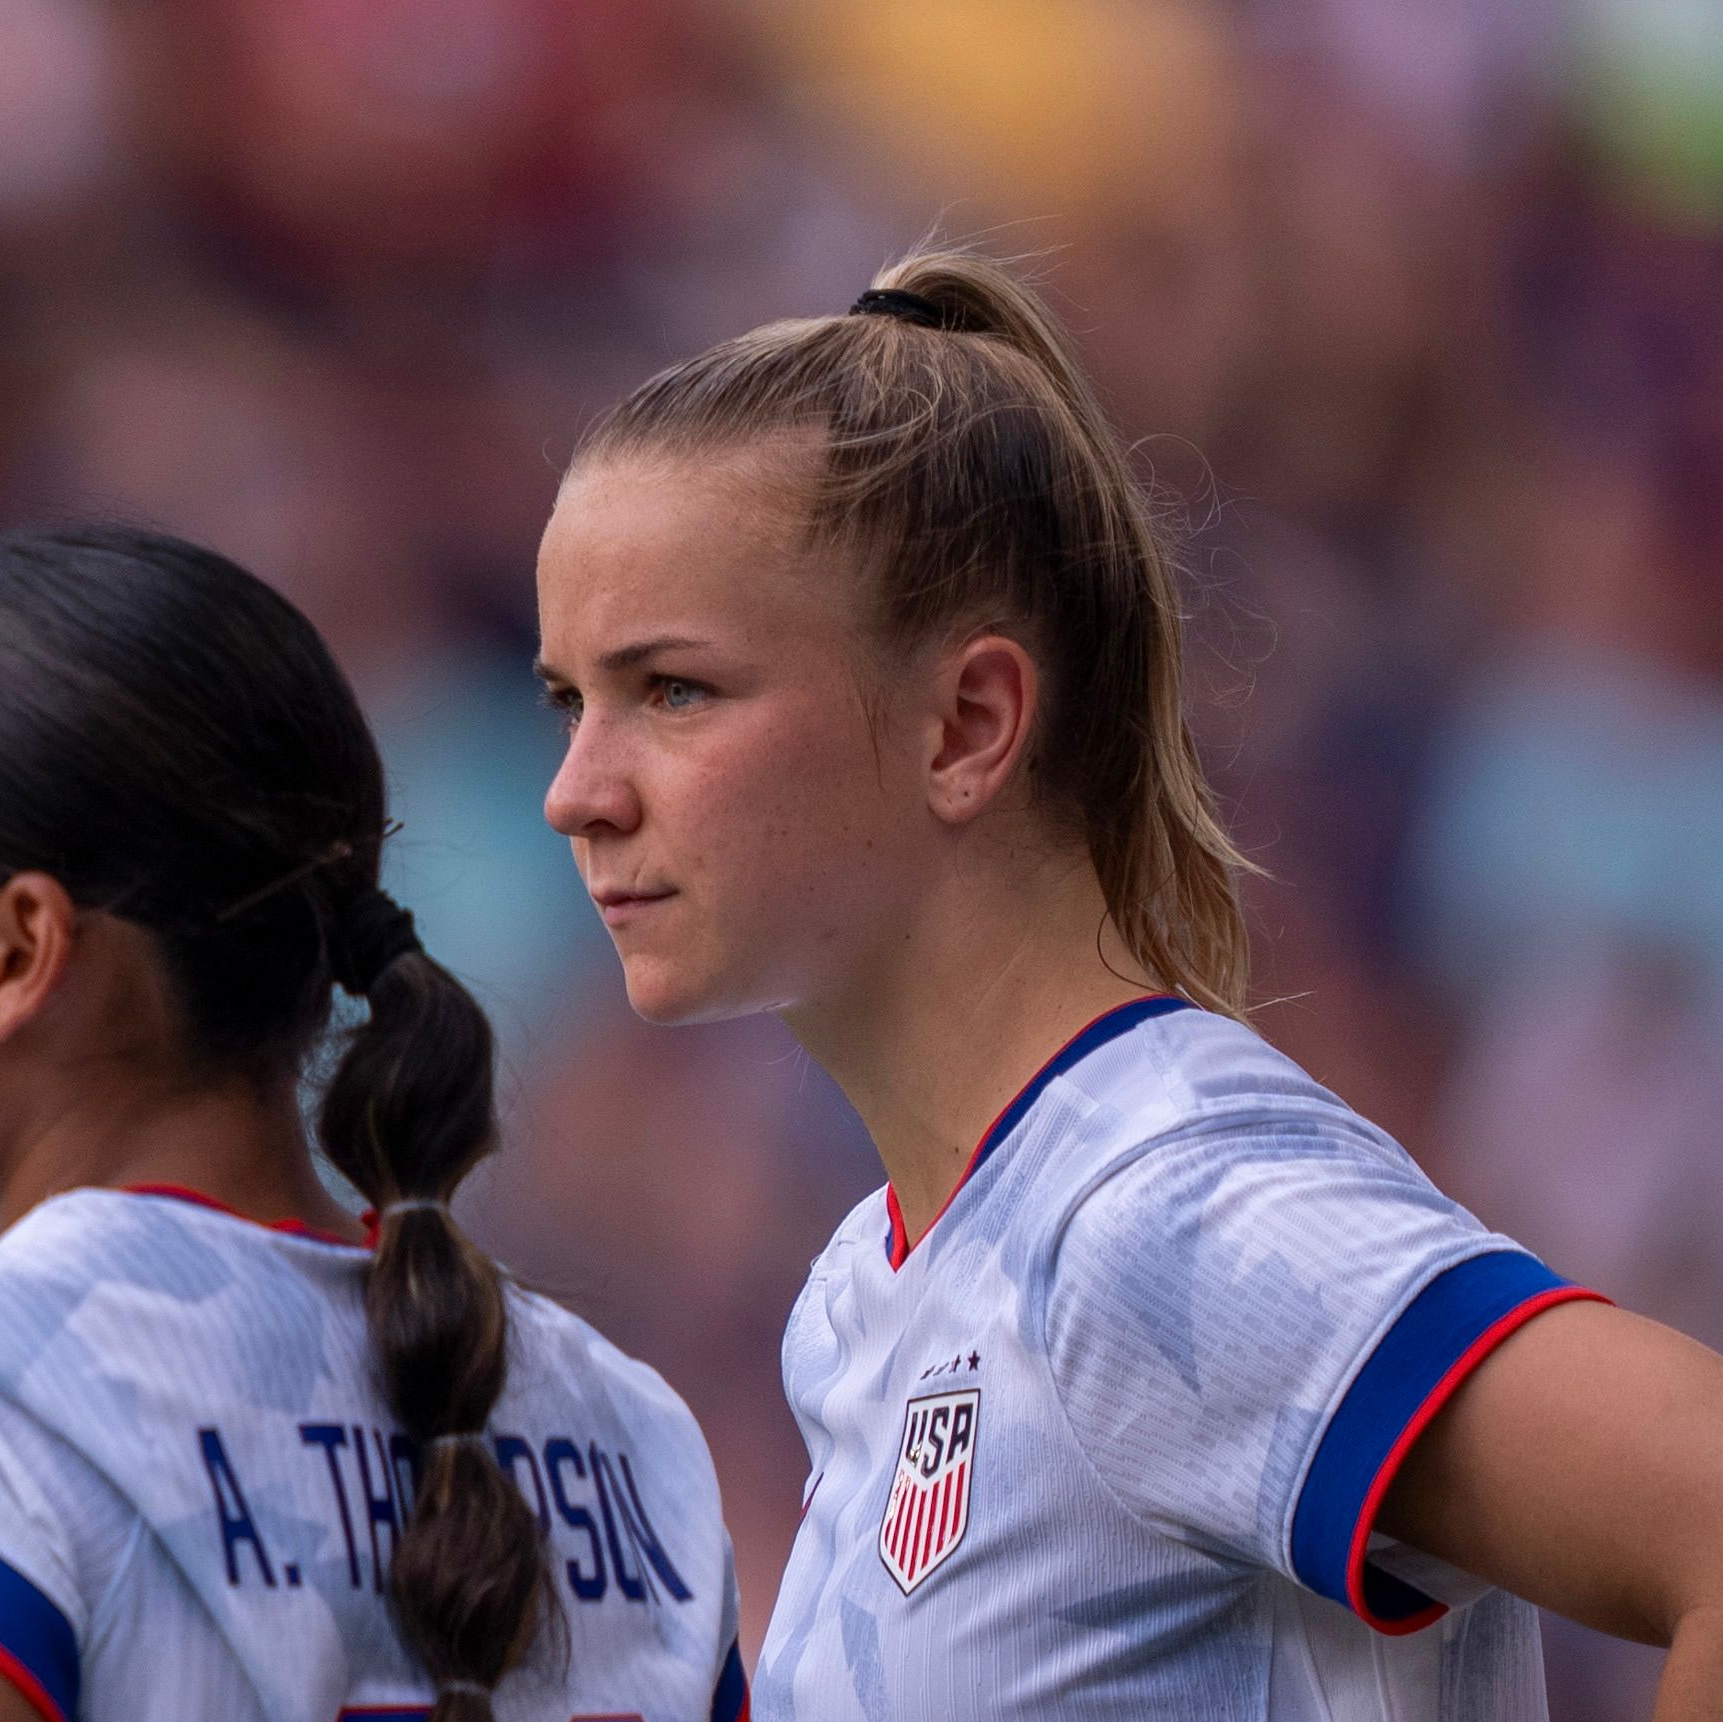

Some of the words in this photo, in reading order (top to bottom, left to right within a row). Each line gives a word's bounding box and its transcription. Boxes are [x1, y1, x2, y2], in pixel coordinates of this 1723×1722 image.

[905, 1403, 974, 1479] USA
[197, 1426, 302, 1588] A.
[298, 1423, 694, 1604] THPSON
